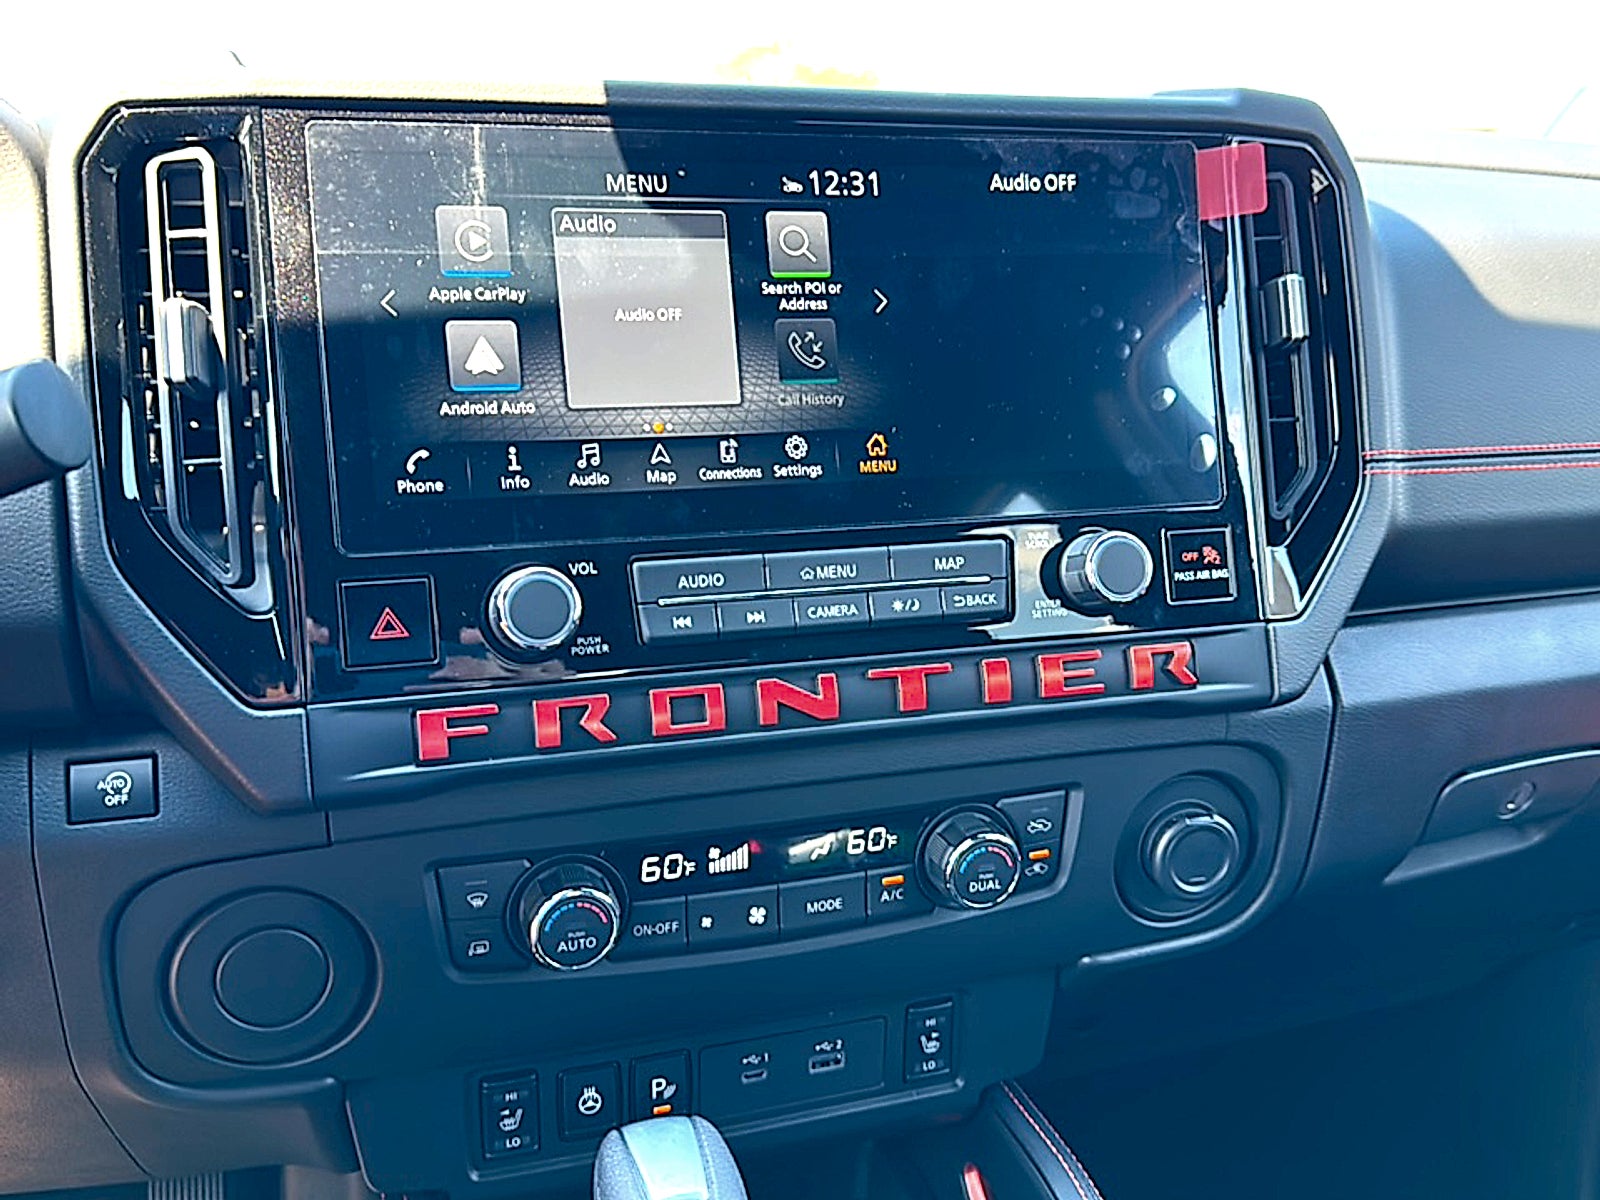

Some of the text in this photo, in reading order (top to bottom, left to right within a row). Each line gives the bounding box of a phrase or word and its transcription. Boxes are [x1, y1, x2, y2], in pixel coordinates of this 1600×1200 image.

[605, 174, 668, 193] MENU
[808, 170, 881, 197] 12:31
[989, 173, 1078, 192] Audio OFF
[559, 214, 617, 234] Audio
[428, 287, 527, 304] Apple CarPlay
[761, 281, 843, 295] Search POI or
[779, 297, 829, 311] Address
[614, 308, 683, 322] Audio OFF
[439, 400, 536, 416] Android Auto
[778, 393, 845, 408] Call History
[698, 466, 763, 481] Connections
[773, 463, 823, 479] Settings
[859, 459, 897, 474] MENU
[500, 476, 531, 490] Info
[569, 473, 610, 487] Audio
[646, 470, 677, 485] Map
[396, 479, 445, 494] Phone
[934, 556, 965, 572] MAP
[1181, 551, 1199, 562] OFF
[568, 562, 598, 576] VOL
[815, 563, 858, 580] MENU
[1173, 568, 1230, 581] PASS AIR BAG
[677, 573, 726, 589] AUDIO
[966, 593, 997, 607] BACK
[807, 604, 859, 619] CAMERA
[576, 635, 602, 645] PUSH
[570, 643, 610, 657] POWER
[415, 641, 1198, 762] FRONTIER
[104, 793, 129, 807] OFF
[968, 878, 1002, 893] DUAL
[880, 888, 904, 903] A/C
[805, 897, 843, 914] MODE
[633, 921, 680, 937] ON-OFF
[556, 936, 597, 953] AUTO
[925, 1018, 937, 1027] HI
[922, 1060, 937, 1071] LO
[505, 1091, 518, 1102] HI
[651, 1078, 667, 1100] P
[506, 1136, 522, 1148] LO
